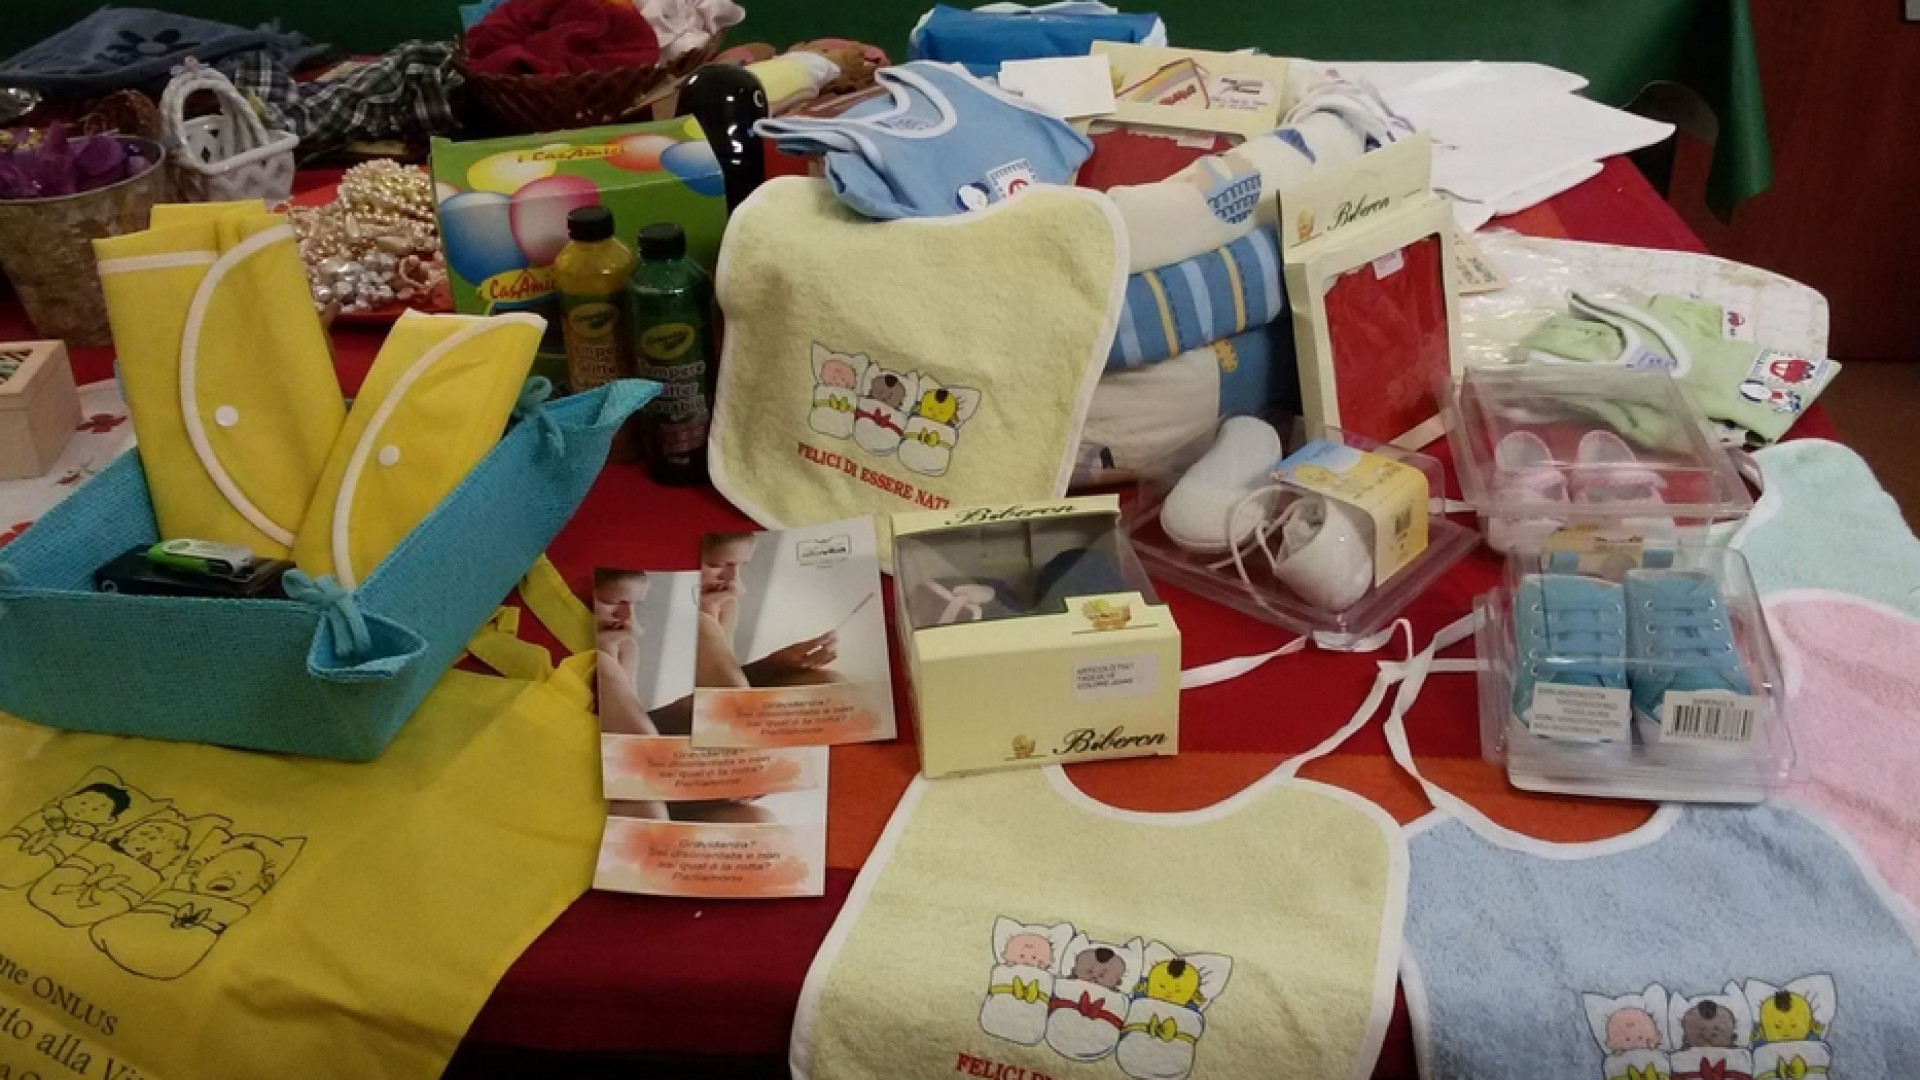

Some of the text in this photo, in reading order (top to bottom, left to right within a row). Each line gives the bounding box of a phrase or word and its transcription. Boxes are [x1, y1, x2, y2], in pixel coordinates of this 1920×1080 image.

[797, 441, 842, 469] FELICI
[843, 458, 858, 478] DI
[860, 466, 914, 500] ESSERE
[944, 503, 1074, 525] Biberon
[1052, 725, 1166, 755] Biberon
[0, 952, 118, 1036] ne ONLUS
[0, 1006, 34, 1041] to
[36, 1032, 92, 1075] alla
[955, 1051, 1026, 1080] FELICI
